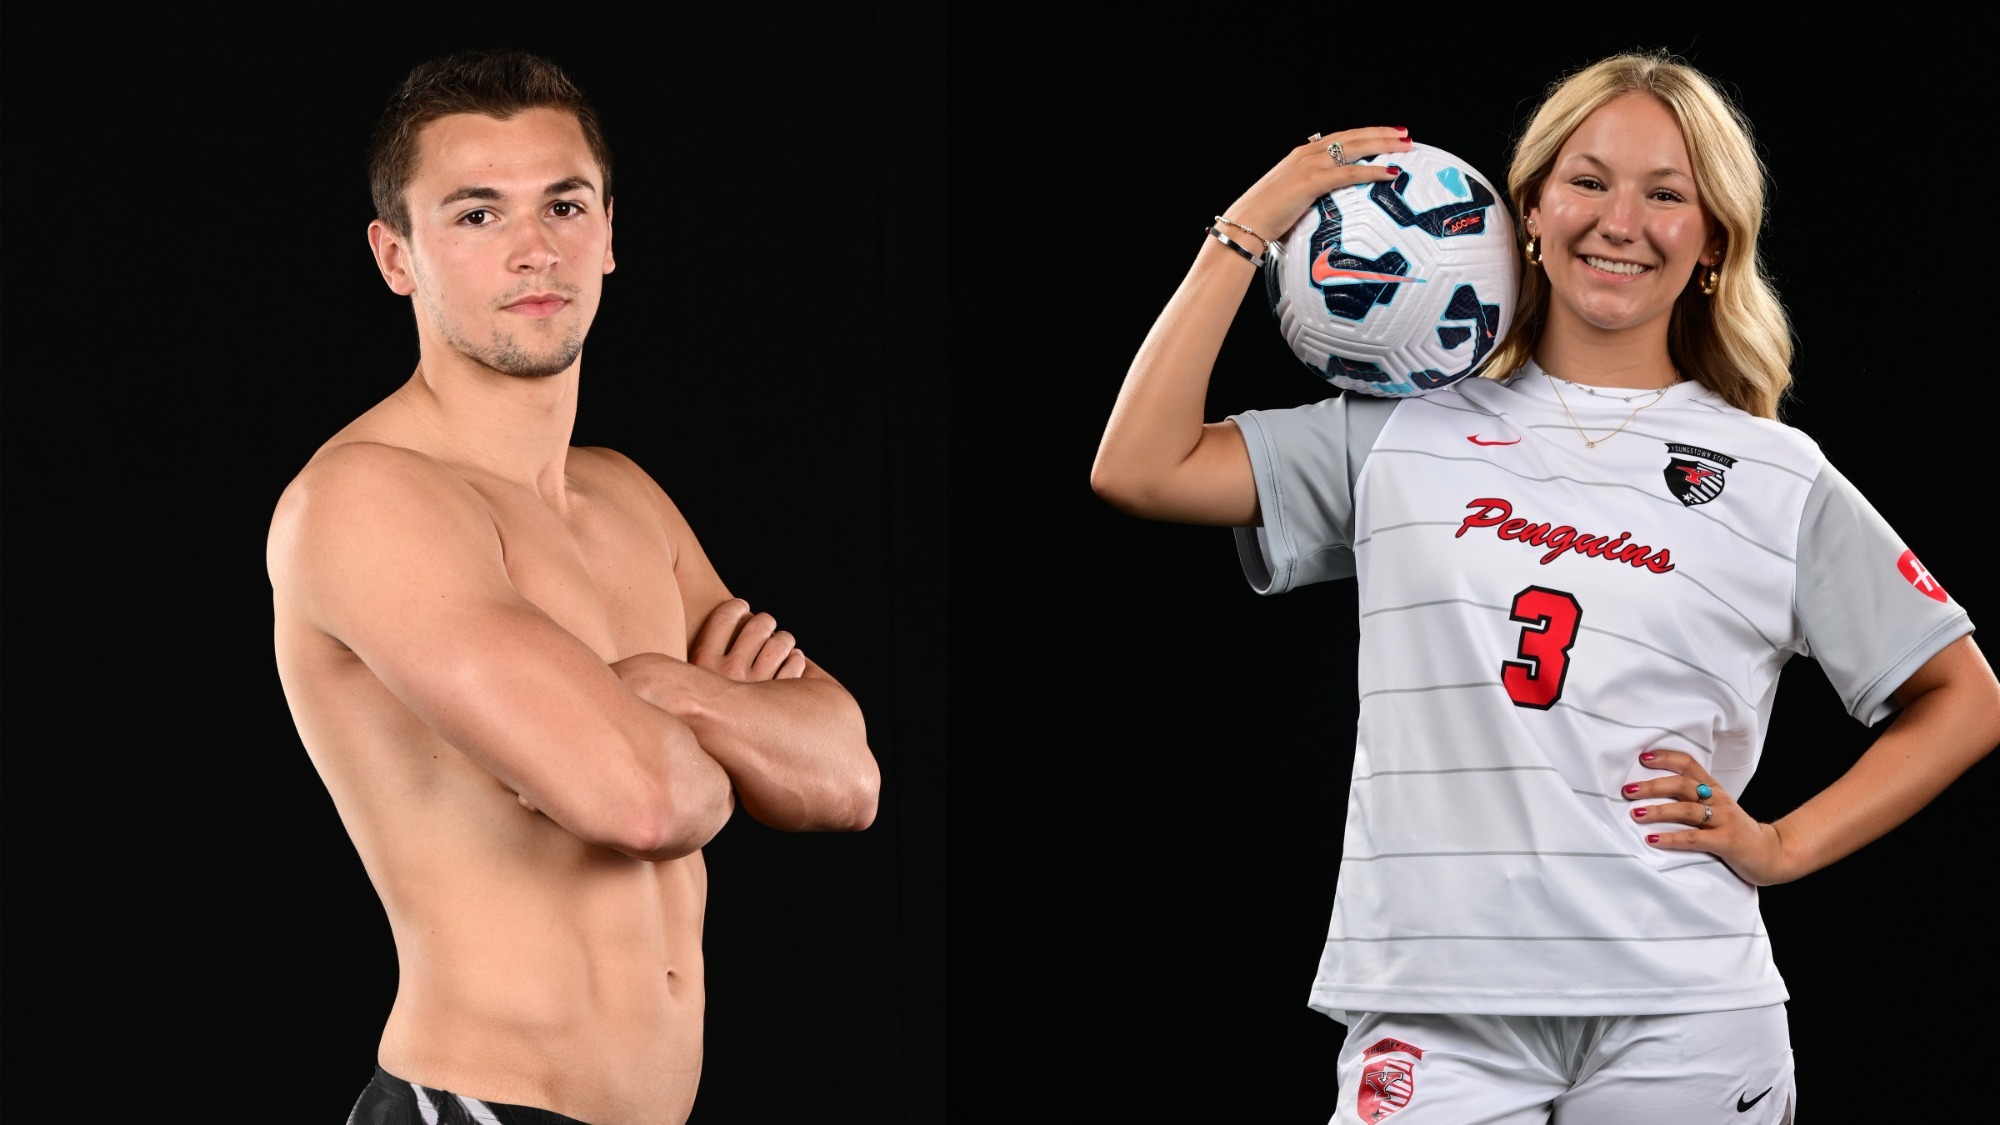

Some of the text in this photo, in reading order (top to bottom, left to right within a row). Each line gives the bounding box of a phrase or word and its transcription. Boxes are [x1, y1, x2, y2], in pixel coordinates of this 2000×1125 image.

[1670, 445, 1731, 466] YOUNGSTOWN STATE
[1455, 497, 1675, 574] Penguins
[1500, 584, 1583, 712] 3
[1366, 1071, 1404, 1101] Y
